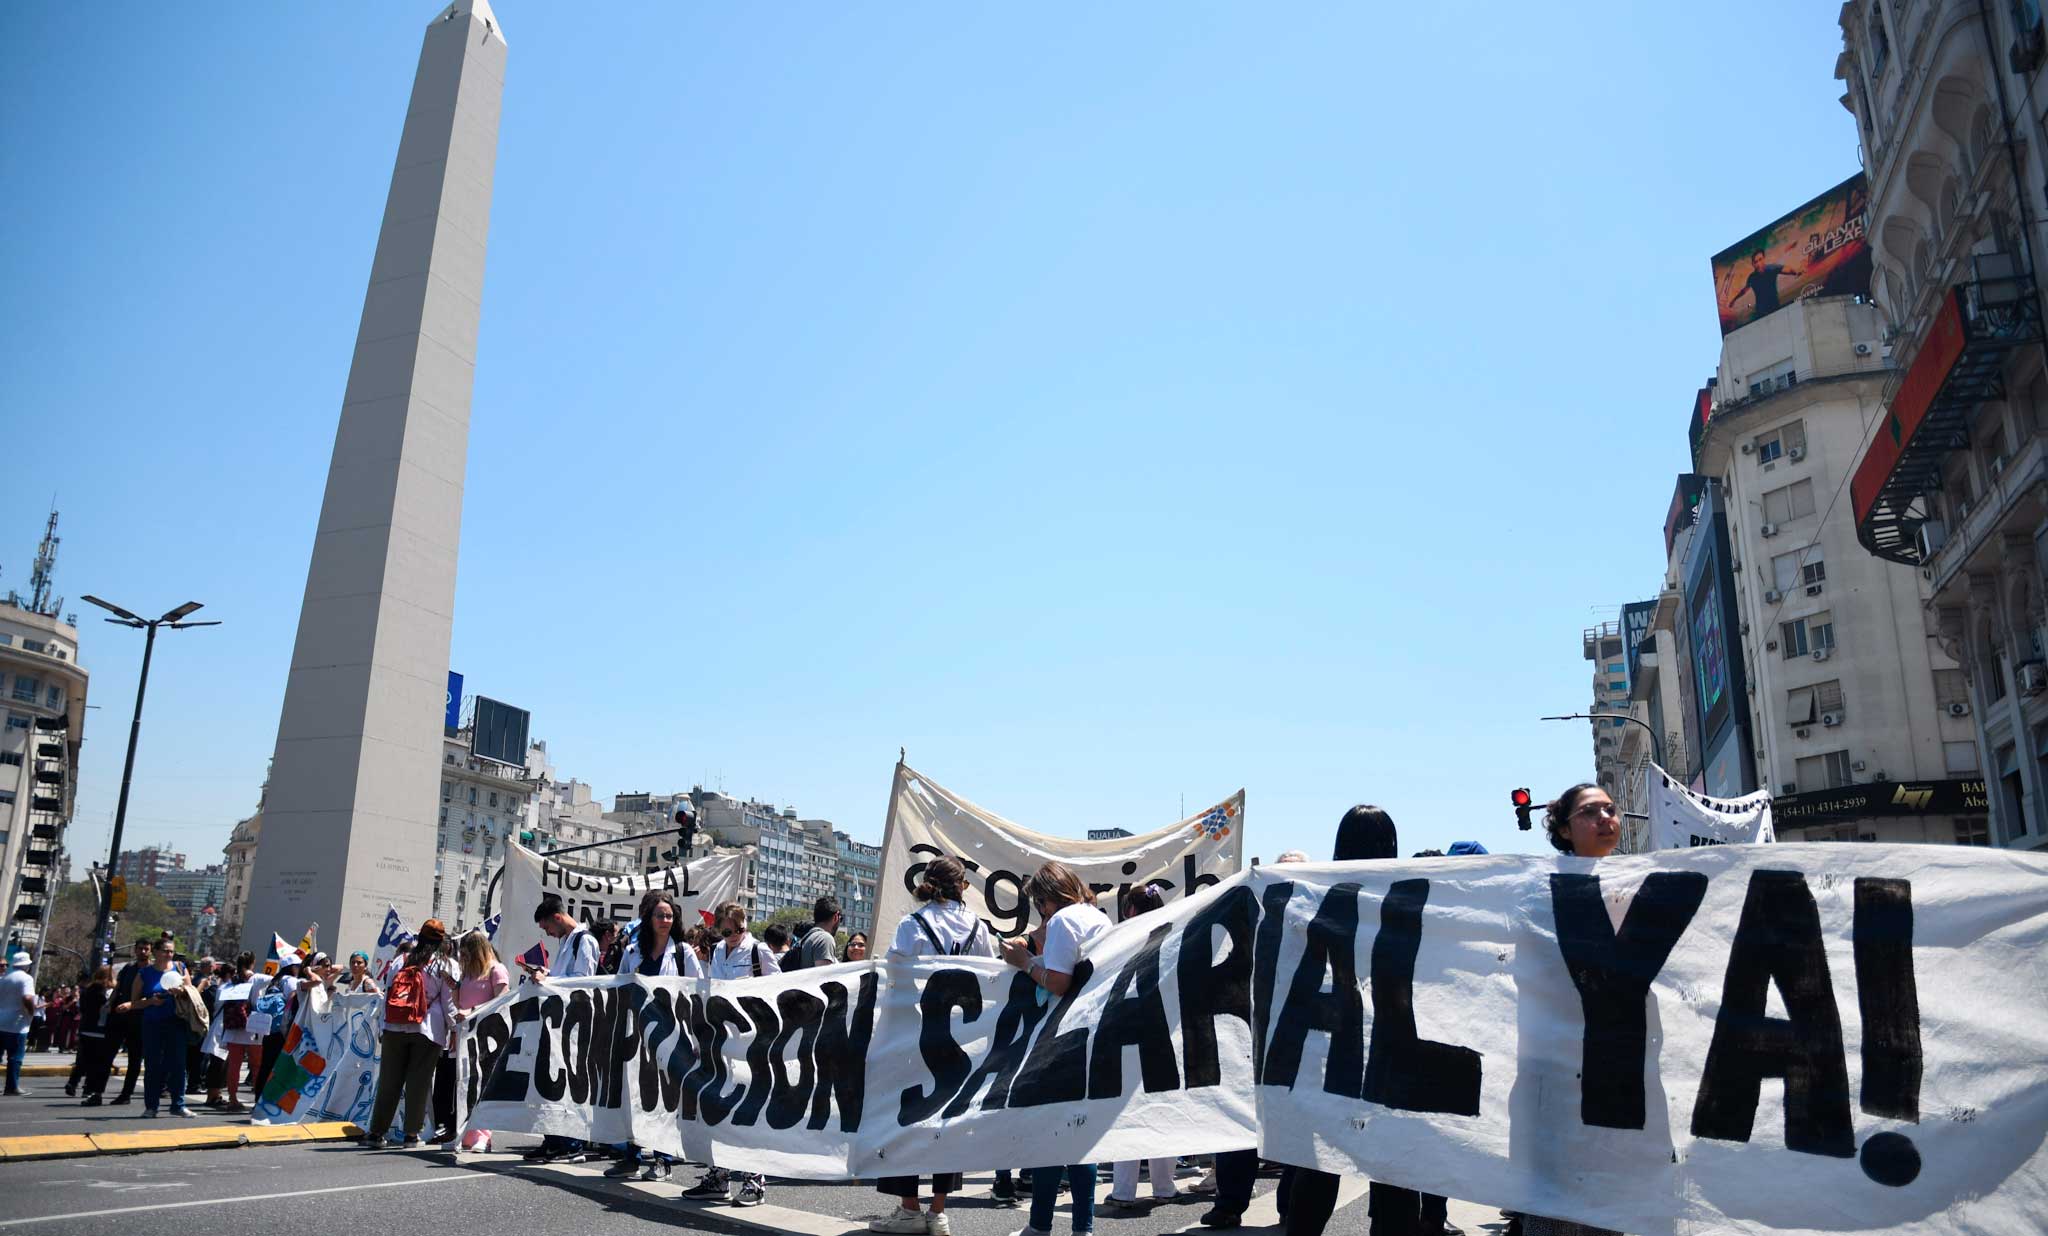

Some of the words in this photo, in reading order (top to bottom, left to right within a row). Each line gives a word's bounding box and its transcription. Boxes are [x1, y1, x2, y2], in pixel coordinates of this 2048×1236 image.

[1817, 796, 1866, 813] 4314-2939
[1088, 831, 1121, 840] QUALIA
[1550, 869, 1923, 1188] YA!
